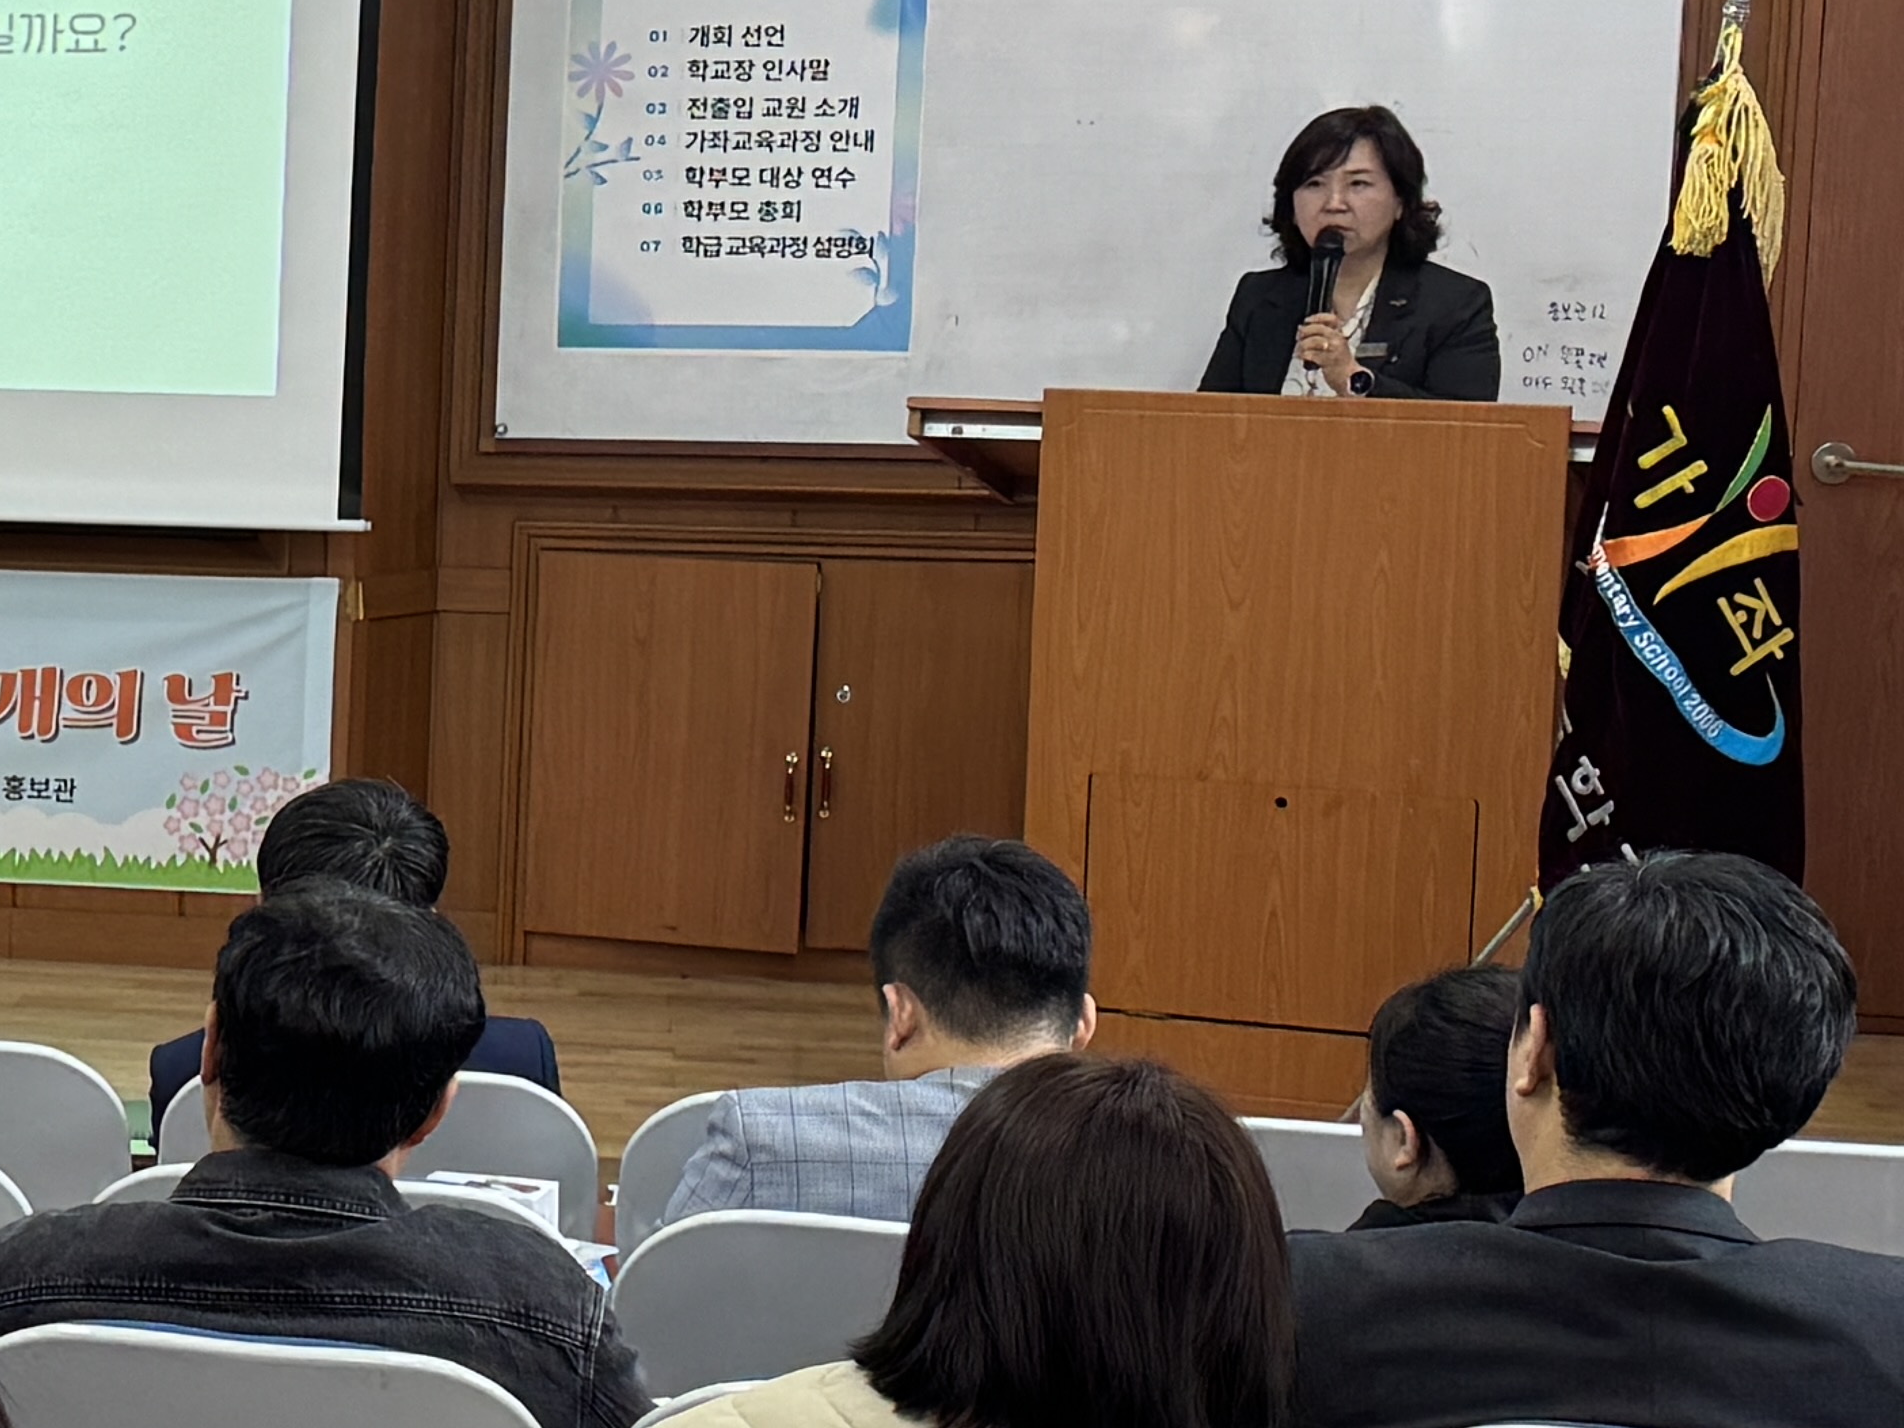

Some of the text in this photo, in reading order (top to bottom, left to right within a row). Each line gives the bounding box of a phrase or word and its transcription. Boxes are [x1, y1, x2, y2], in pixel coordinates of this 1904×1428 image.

[649, 24, 785, 48] 01 개회 선언
[648, 58, 830, 83] 02 학교장 인사말
[646, 96, 860, 120] 03 전출입 교원 소개
[644, 129, 875, 154] 04 가좌교육과정 안내
[643, 166, 856, 189] 05 학부모 대상 연수
[683, 200, 750, 223] 학부모
[757, 199, 802, 223] 총회
[640, 239, 661, 252] 07
[812, 236, 875, 259] 설명회
[1634, 405, 1794, 676] 가 좌
[1633, 631, 1692, 697] School
[163, 668, 250, 749] 날
[2, 774, 78, 803] 홍보관
[1554, 755, 1615, 843] 학
